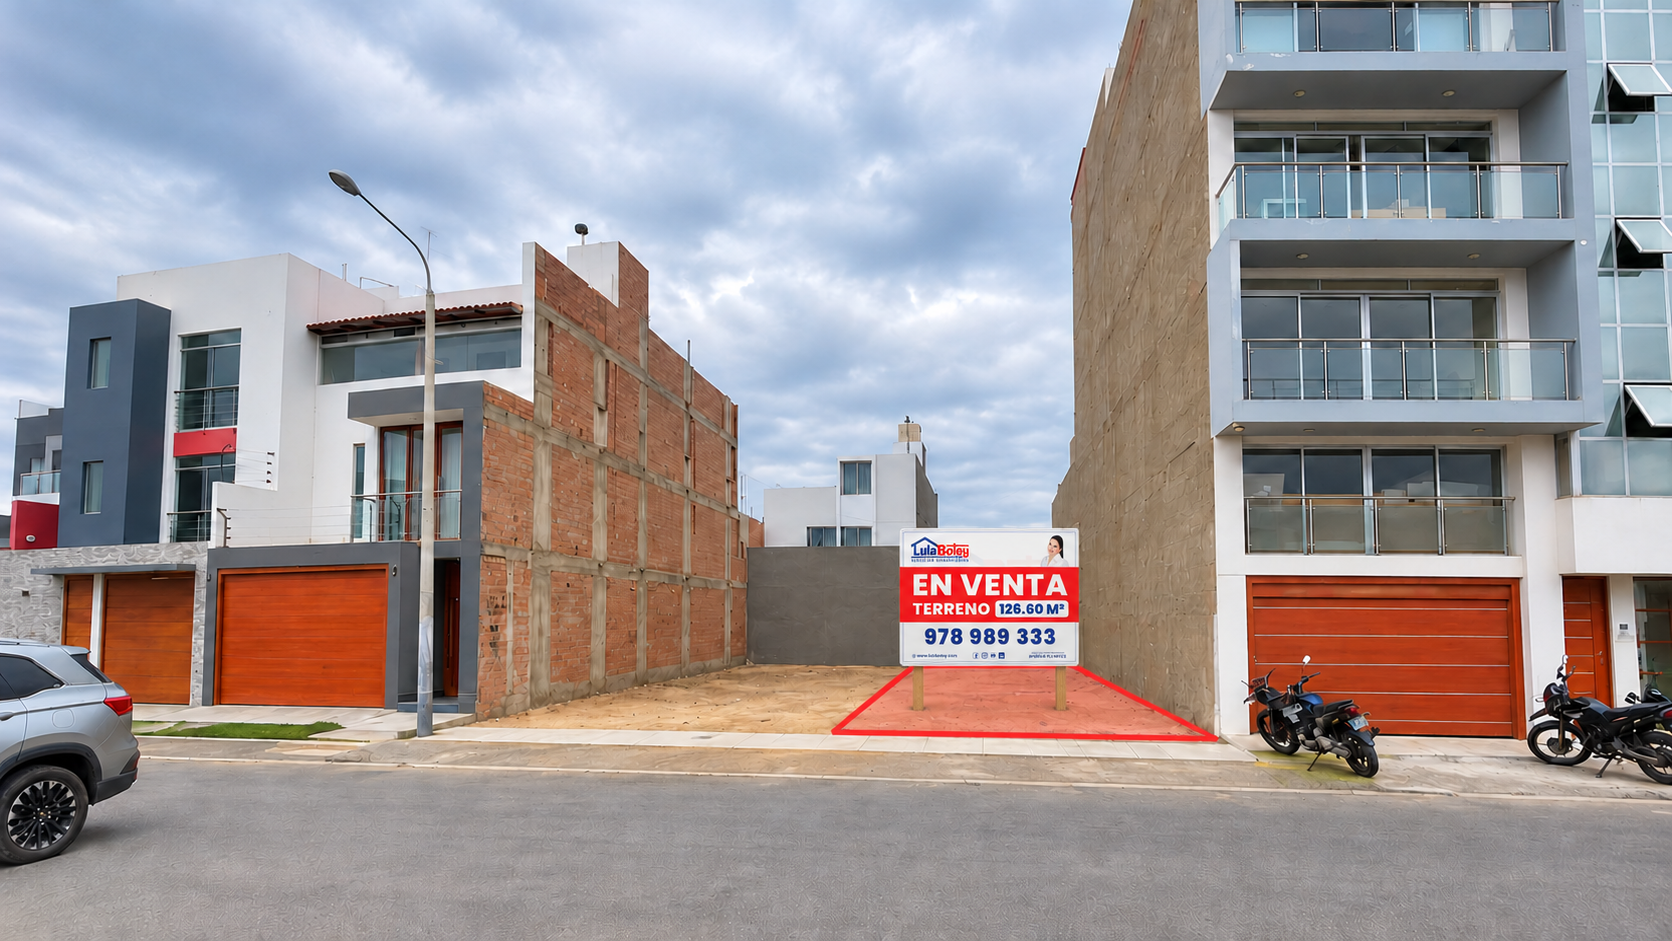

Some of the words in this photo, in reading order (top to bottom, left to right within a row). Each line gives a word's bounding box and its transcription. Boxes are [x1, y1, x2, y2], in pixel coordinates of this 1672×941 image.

[913, 574, 952, 596] EN
[960, 574, 1068, 596] VENTA
[913, 602, 990, 615] TERRENO
[999, 603, 1043, 615] 126.60
[924, 628, 963, 645] 978
[969, 628, 1010, 645] 989
[1016, 628, 1056, 645] 333
